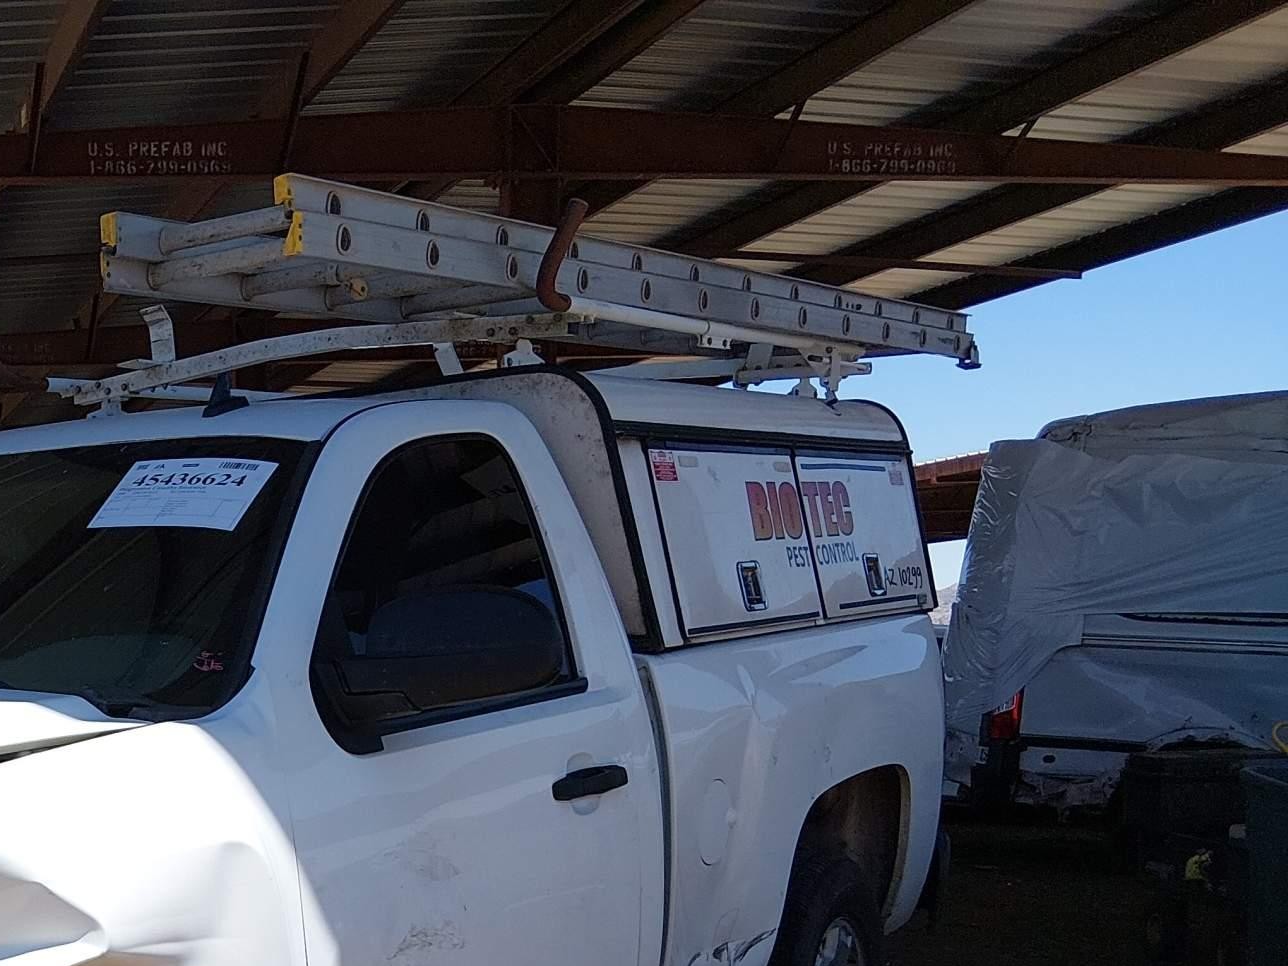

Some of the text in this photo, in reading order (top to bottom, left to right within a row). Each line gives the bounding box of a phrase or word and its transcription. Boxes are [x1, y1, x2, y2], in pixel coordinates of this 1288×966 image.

[87, 142, 120, 156] U.S.
[128, 142, 193, 156] PREFAB
[864, 143, 922, 156] PREFAB
[132, 473, 247, 487] 45436624
[786, 541, 859, 567] PEST CONTROL
